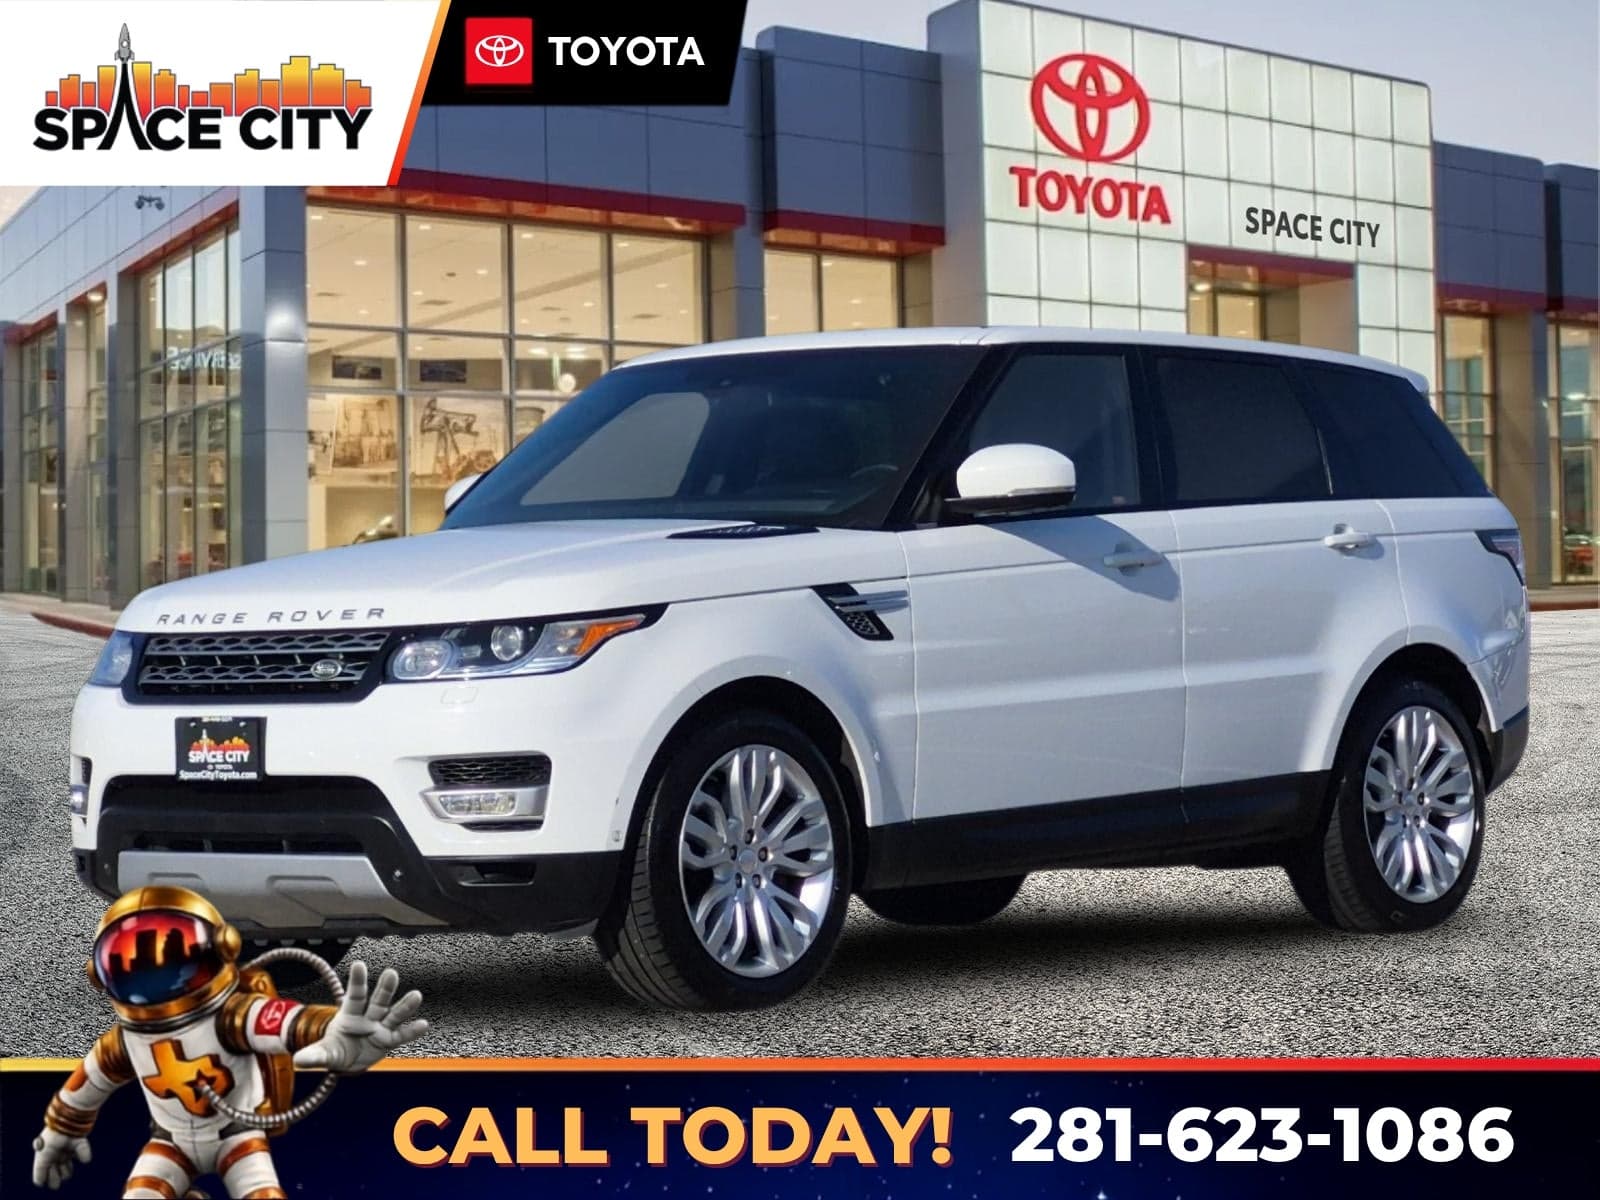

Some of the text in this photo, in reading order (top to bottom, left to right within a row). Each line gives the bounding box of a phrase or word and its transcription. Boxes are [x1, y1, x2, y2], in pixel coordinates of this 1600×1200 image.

[1009, 166, 1171, 225] TOYOTA
[1245, 207, 1380, 248] SPACE CITY
[157, 608, 385, 625] RANGE ROVER
[188, 749, 250, 763] SPACE CITY
[179, 770, 258, 781] SpaceCityToyota.com
